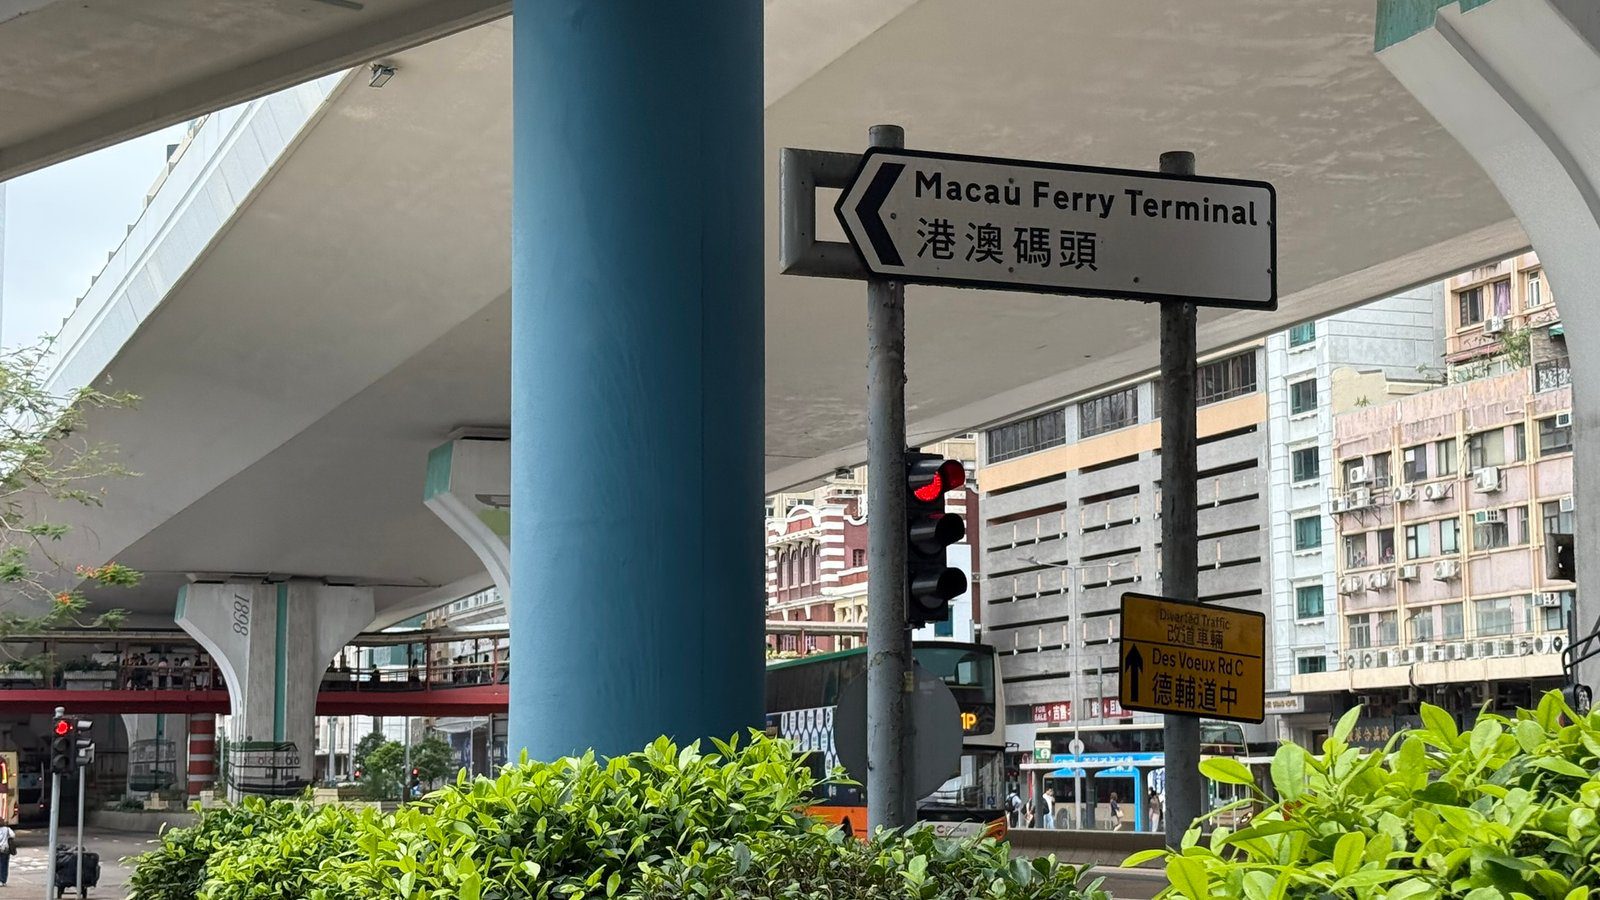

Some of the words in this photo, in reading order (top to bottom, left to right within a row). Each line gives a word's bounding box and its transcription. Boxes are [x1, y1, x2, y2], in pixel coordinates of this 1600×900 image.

[915, 170, 1021, 207] Macau
[1033, 181, 1116, 219] Ferry
[1124, 188, 1258, 227] Terminal
[917, 217, 1100, 273] 港澳碼頭
[232, 593, 250, 636] 1898
[1160, 608, 1200, 626] Diverted
[1202, 614, 1230, 630] Traffic
[1167, 623, 1224, 650] 改道車輛
[1152, 648, 1176, 668] Des
[1179, 651, 1216, 673] Voeux
[1218, 657, 1233, 676] Rd
[1235, 659, 1244, 677] C
[1152, 671, 1238, 714] 德輔道中
